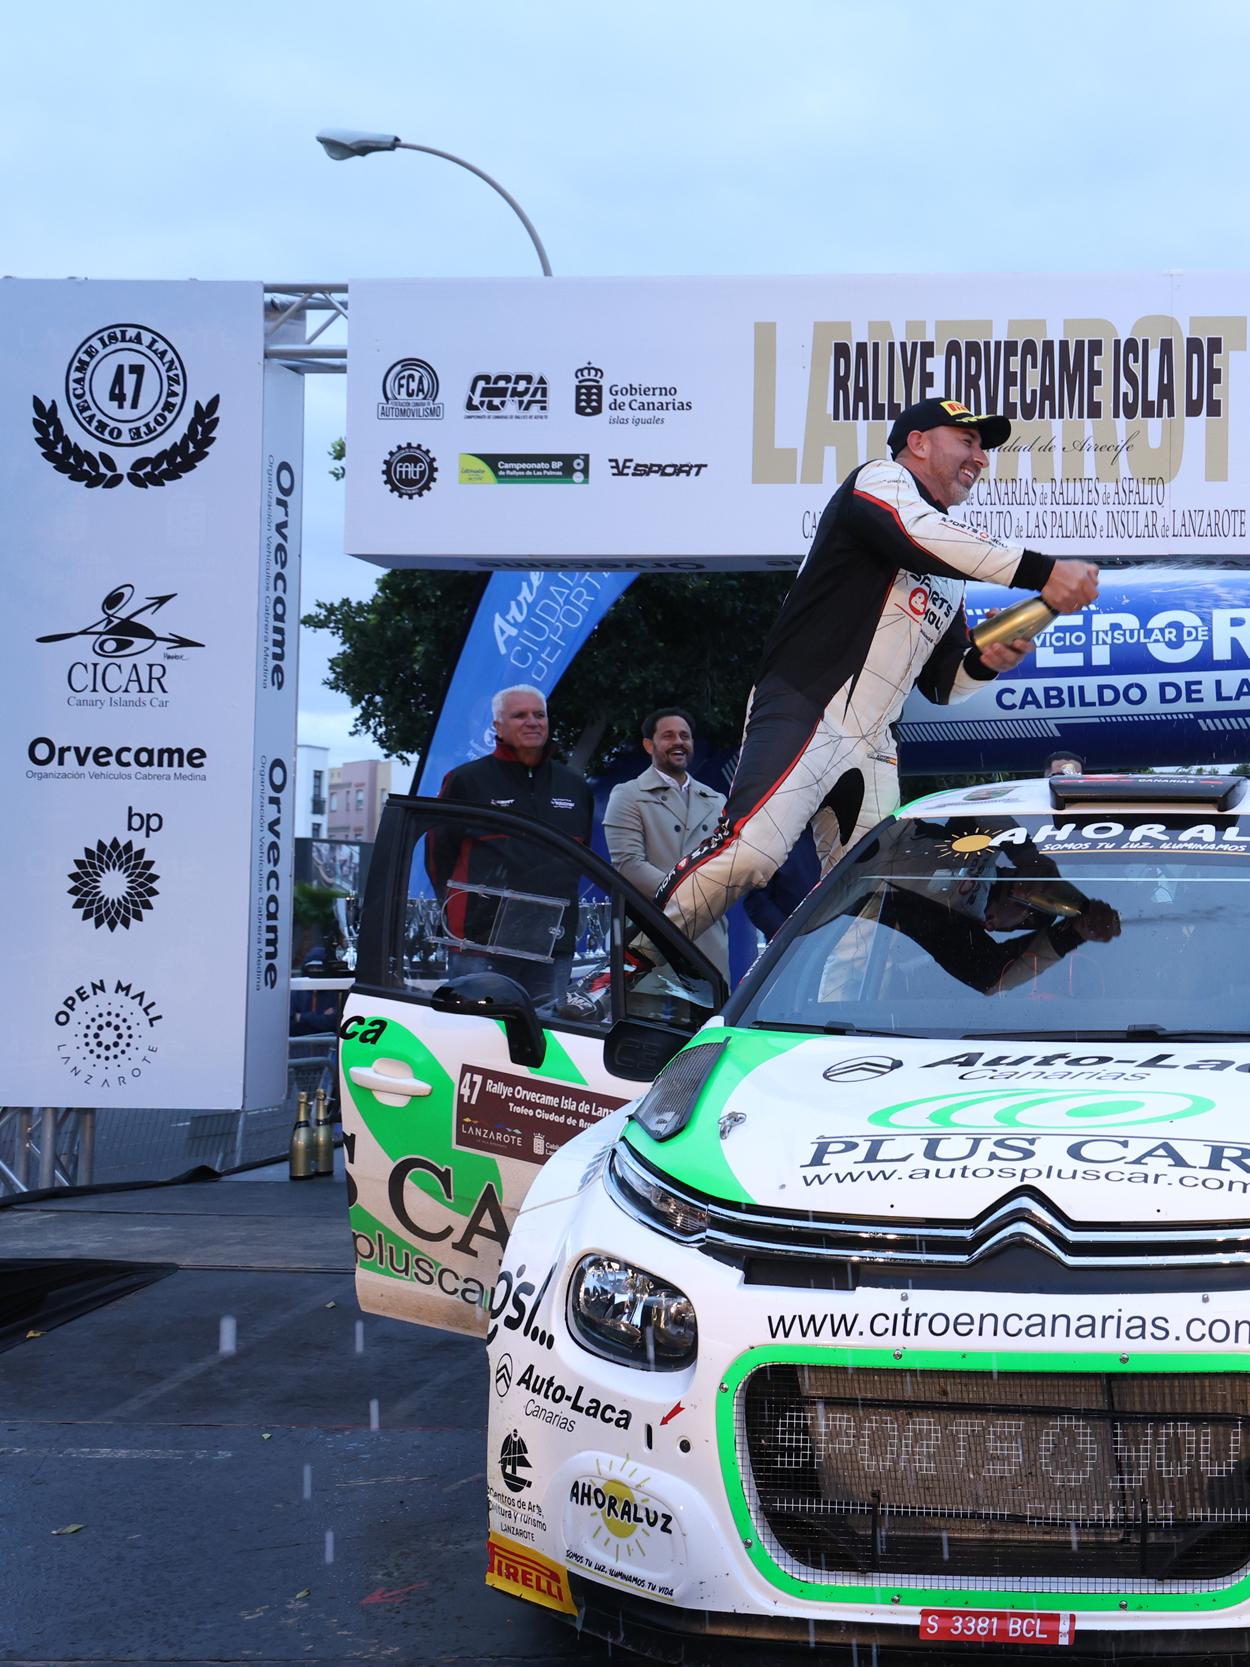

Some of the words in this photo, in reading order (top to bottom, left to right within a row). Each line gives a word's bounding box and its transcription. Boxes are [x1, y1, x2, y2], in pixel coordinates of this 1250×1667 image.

[72, 343, 123, 440] ORVECAME
[99, 329, 143, 350] ISLA
[129, 336, 181, 440] LANZAROTE
[108, 363, 146, 411] 47
[398, 373, 425, 398] FCA
[609, 384, 677, 397] Gobierno
[833, 341, 935, 421] RALLYE
[945, 338, 1103, 420] ORVECAME
[1113, 337, 1174, 420] ISLA
[1186, 337, 1223, 418] DE
[380, 405, 441, 418] AUTOMOVILISMO
[609, 399, 625, 411] de
[628, 399, 692, 411] Canarias
[609, 415, 628, 425] islas
[632, 415, 665, 427] iguales
[1062, 430, 1136, 465] Arrecife
[498, 461, 550, 471] Campeonato
[552, 461, 563, 469] BP
[977, 478, 1036, 506] CANARIAS
[1050, 478, 1100, 506] RALLYES
[1114, 477, 1165, 506] ASFALTO
[1025, 510, 1047, 539] LAS
[1050, 510, 1098, 539] PALMAS
[1106, 510, 1159, 539] INSULAR
[1171, 509, 1247, 539] LANZAROTE
[270, 460, 295, 692] Orvecame
[1092, 628, 1177, 645] INSULAR
[1183, 626, 1209, 641] DE
[66, 661, 168, 694] CICAR
[67, 696, 106, 709] Canary
[108, 696, 147, 708] Islands
[150, 697, 169, 708] Car
[996, 680, 1147, 712] CABILDO
[1159, 680, 1204, 705] DE
[27, 736, 207, 769] Orvecame
[26, 769, 86, 781] Organización
[88, 770, 132, 781] Vehículos
[134, 771, 172, 781] Cabrera
[173, 771, 207, 781] Medina
[126, 805, 164, 838] bp
[1042, 842, 1092, 851] SOMOS
[1096, 842, 1117, 850] TU
[1159, 843, 1247, 853] ILUMINAMOS
[264, 757, 288, 990] Orvecame
[54, 979, 107, 1027] OPEN
[114, 979, 164, 1028] MALL
[57, 1042, 159, 1089] LANZAROTE
[959, 1067, 1153, 1083] Canarias
[460, 1072, 483, 1105] 47
[486, 1079, 513, 1099] Rallye
[514, 1086, 559, 1108] Orvecame
[560, 1095, 577, 1112] Isla
[578, 1100, 590, 1114] de
[508, 1103, 534, 1117] Trofeo
[535, 1109, 565, 1124] Ciudad
[566, 1115, 578, 1127] de
[461, 1124, 523, 1147] LANZAROTE
[801, 1135, 1037, 1169] PLUS
[516, 1363, 633, 1431] Auto-Laca
[525, 1398, 577, 1433] Canarias
[777, 1411, 1026, 1476] SPORTS
[516, 1498, 526, 1509] de
[569, 1480, 674, 1535] AHORALUZ
[500, 1523, 535, 1542] LANZAROTE
[566, 1549, 584, 1564] SOMOS
[584, 1558, 593, 1567] TU
[608, 1566, 646, 1588] ILUMINAMOS
[646, 1581, 657, 1591] TU
[658, 1583, 674, 1597] VIDA
[926, 1614, 939, 1635] S
[950, 1615, 998, 1636] 3381
[1008, 1617, 1048, 1639] BCL
